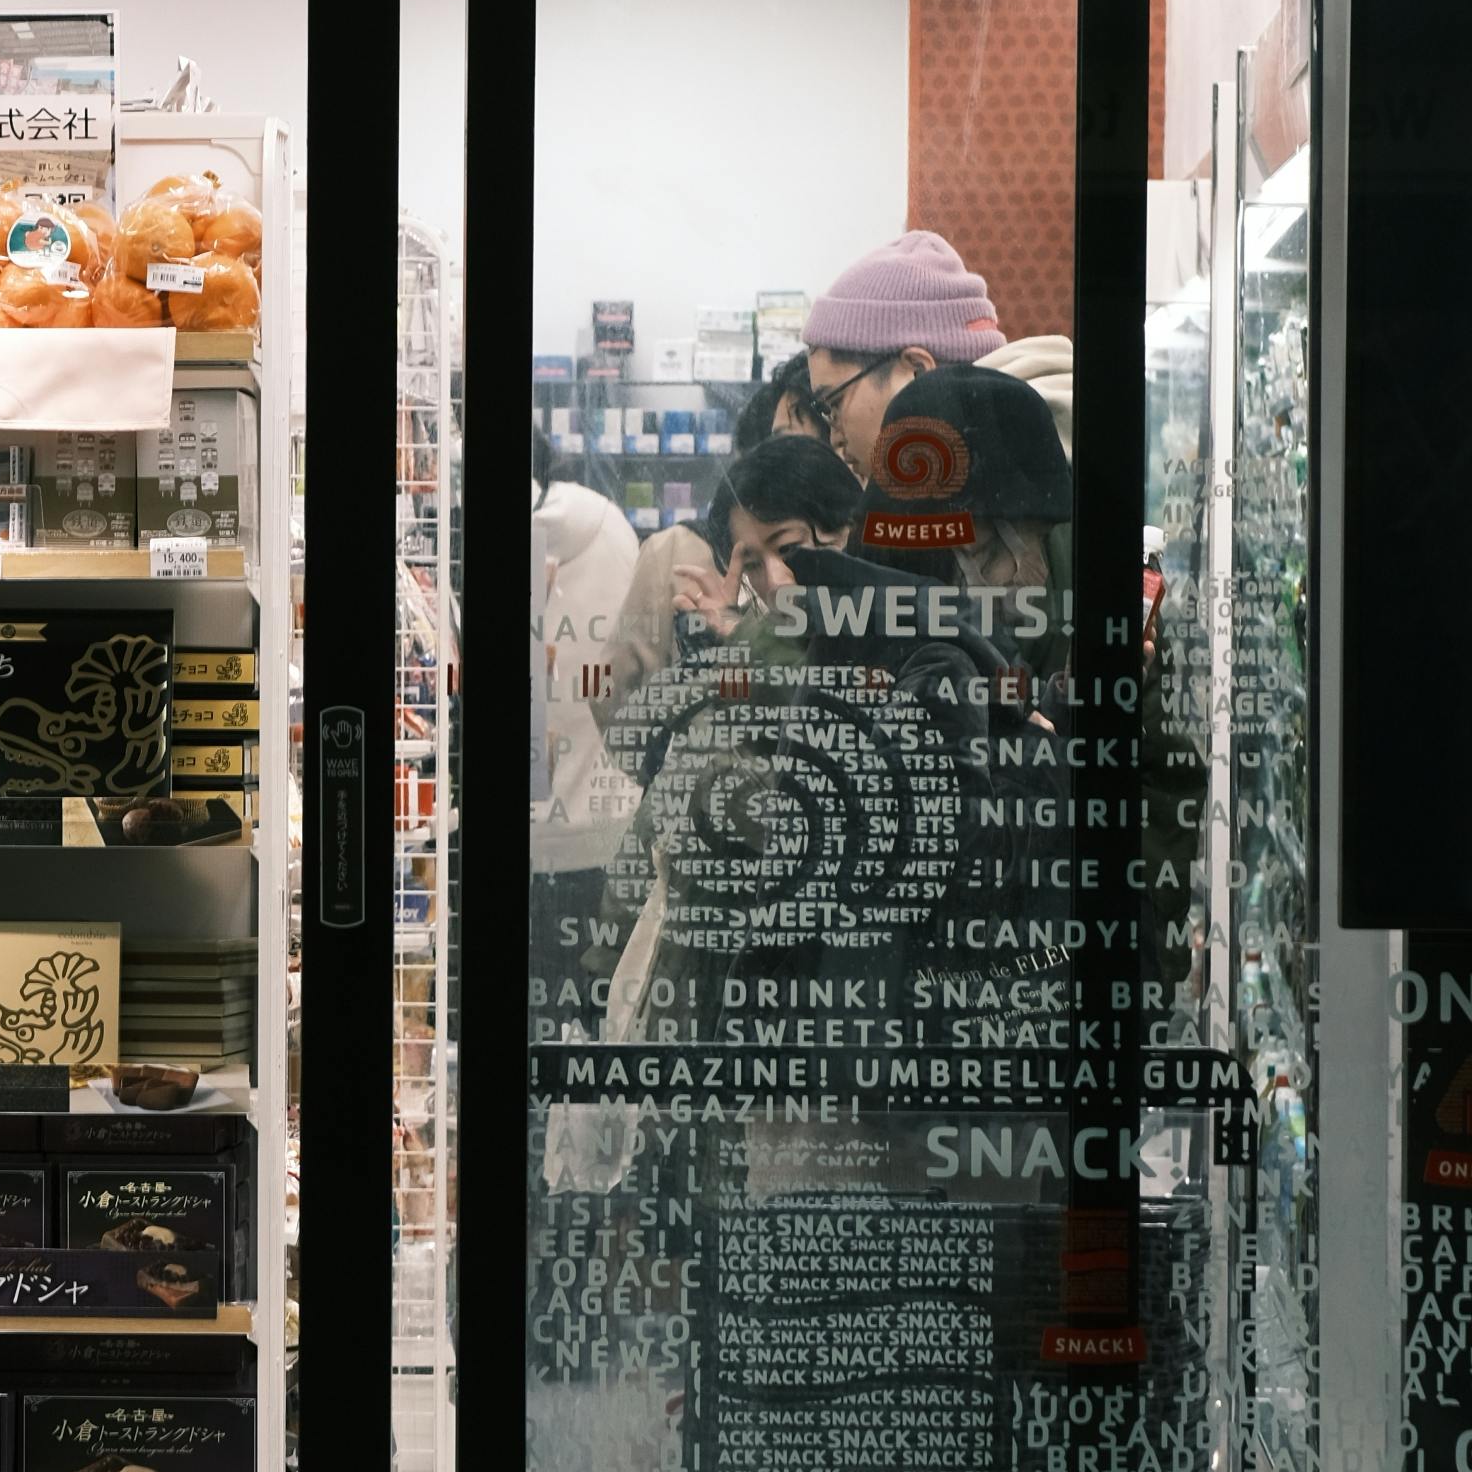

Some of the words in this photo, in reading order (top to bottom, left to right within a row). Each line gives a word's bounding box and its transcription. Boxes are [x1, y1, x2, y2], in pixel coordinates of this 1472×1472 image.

[874, 520, 966, 540] SWEETS!
[773, 584, 1075, 639] SWEETS!
[769, 666, 866, 686] SWEETS
[754, 706, 820, 720] SWEETS
[970, 736, 1140, 768] SNACK!
[326, 759, 359, 769] WAVE
[980, 798, 1150, 829] NIGIRI!
[1031, 858, 1101, 889] ICE
[724, 979, 888, 1010] DRINK!
[914, 980, 1084, 1011] SNACK!
[535, 1018, 698, 1049] PAPER!
[725, 1018, 925, 1049] SWEETS!
[952, 1019, 1124, 1050] SNACK!
[566, 1057, 829, 1089] MAGAZINE!
[855, 1058, 1117, 1089] UMBRELLA!
[598, 1094, 860, 1125] MAGAZINE!
[926, 1127, 1186, 1184] SNACK!
[78, 1189, 212, 1209] 小倉トーストラングドシャ
[776, 1214, 873, 1237] SNACK
[879, 1218, 944, 1233] SNACK
[539, 1230, 667, 1259] EETS!
[780, 1237, 844, 1254] SNACK
[850, 1239, 895, 1252] SNACK
[780, 1277, 829, 1291] SNACK
[836, 1277, 891, 1291] SNACK
[832, 1330, 883, 1346] SNACK
[889, 1330, 953, 1346] SNACK
[1055, 1337, 1134, 1355] SNACK!
[905, 1348, 969, 1365] SNACK
[112, 1407, 167, 1423] 名古屋
[820, 1411, 884, 1426] SNACK
[890, 1411, 955, 1426] SNACK
[51, 1418, 227, 1444] 小倉トーストラングドシャ
[917, 1431, 968, 1447] SNAC
[762, 1449, 826, 1466] SNACK
[832, 1449, 897, 1466] SNACK
[902, 1449, 967, 1466] SNACK
